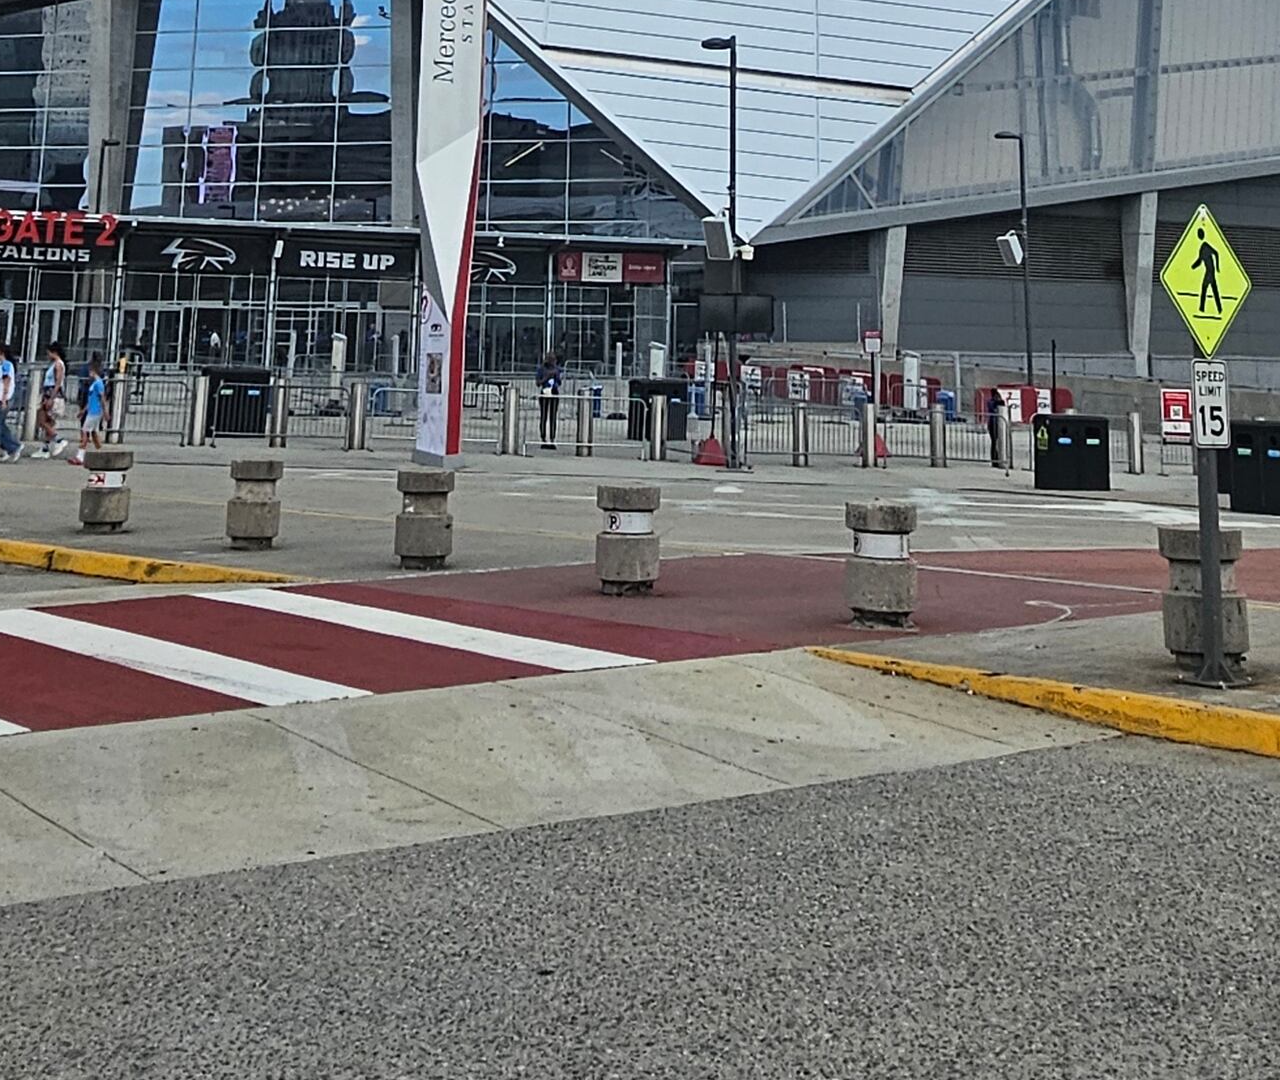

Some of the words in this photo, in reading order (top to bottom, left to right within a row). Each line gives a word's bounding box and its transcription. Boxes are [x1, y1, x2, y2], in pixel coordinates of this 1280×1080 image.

[95, 213, 119, 246] 2
[299, 248, 356, 270] RISE
[362, 252, 395, 271] UP
[1196, 370, 1224, 382] SPEED
[1199, 386, 1222, 397] LIMIT
[1199, 405, 1224, 437] 15
